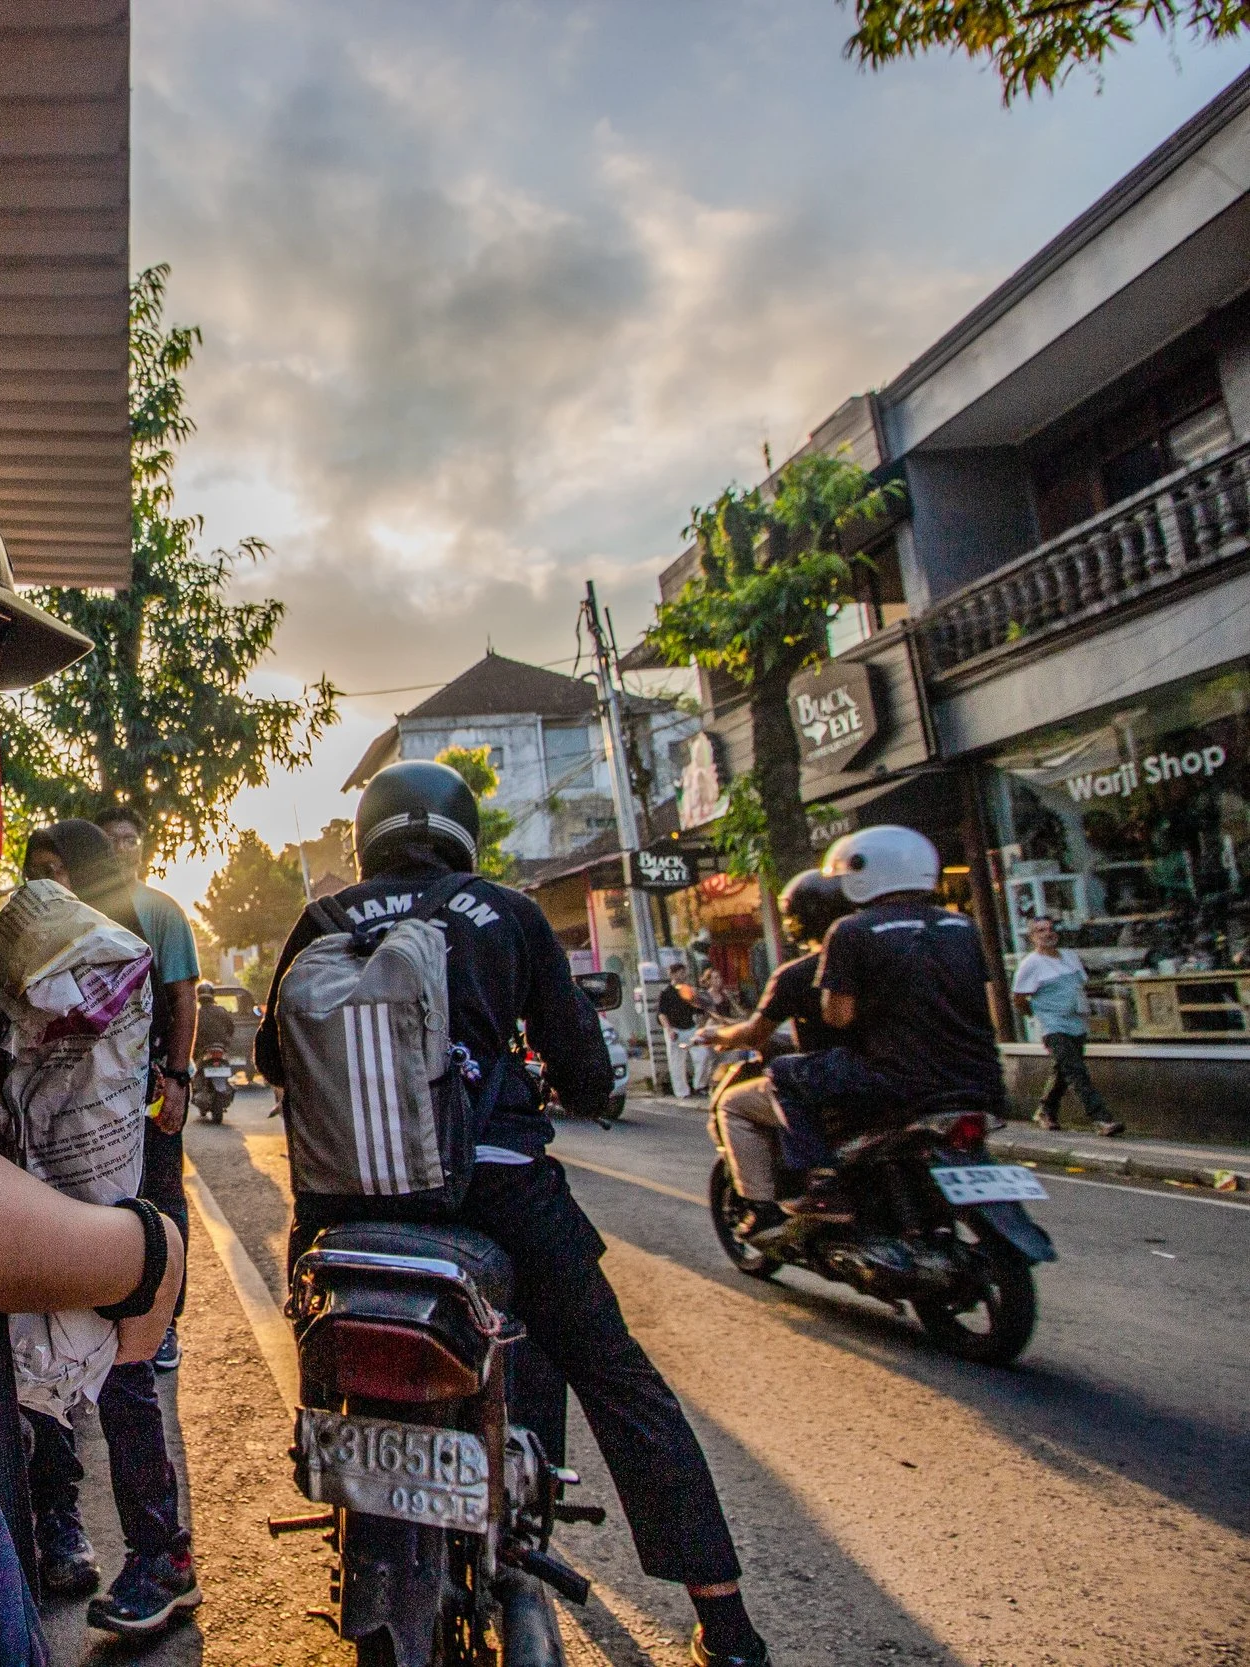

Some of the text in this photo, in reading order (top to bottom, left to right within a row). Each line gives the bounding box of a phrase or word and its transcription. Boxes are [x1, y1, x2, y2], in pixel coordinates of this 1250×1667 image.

[796, 686, 857, 726] BLACK
[829, 706, 863, 738] EYE
[1066, 744, 1227, 802] Warji Shop
[104, 1084, 131, 1101] kata-kata
[113, 1113, 127, 1124] yang
[97, 1121, 112, 1133] ingin
[98, 1125, 125, 1141] langsung
[107, 1138, 120, 1147] kata
[83, 1143, 105, 1155] dengan
[93, 1163, 102, 1171] ini
[103, 1155, 121, 1168] Huruf
[114, 1162, 125, 1171] kata
[95, 1168, 114, 1179] dalam
